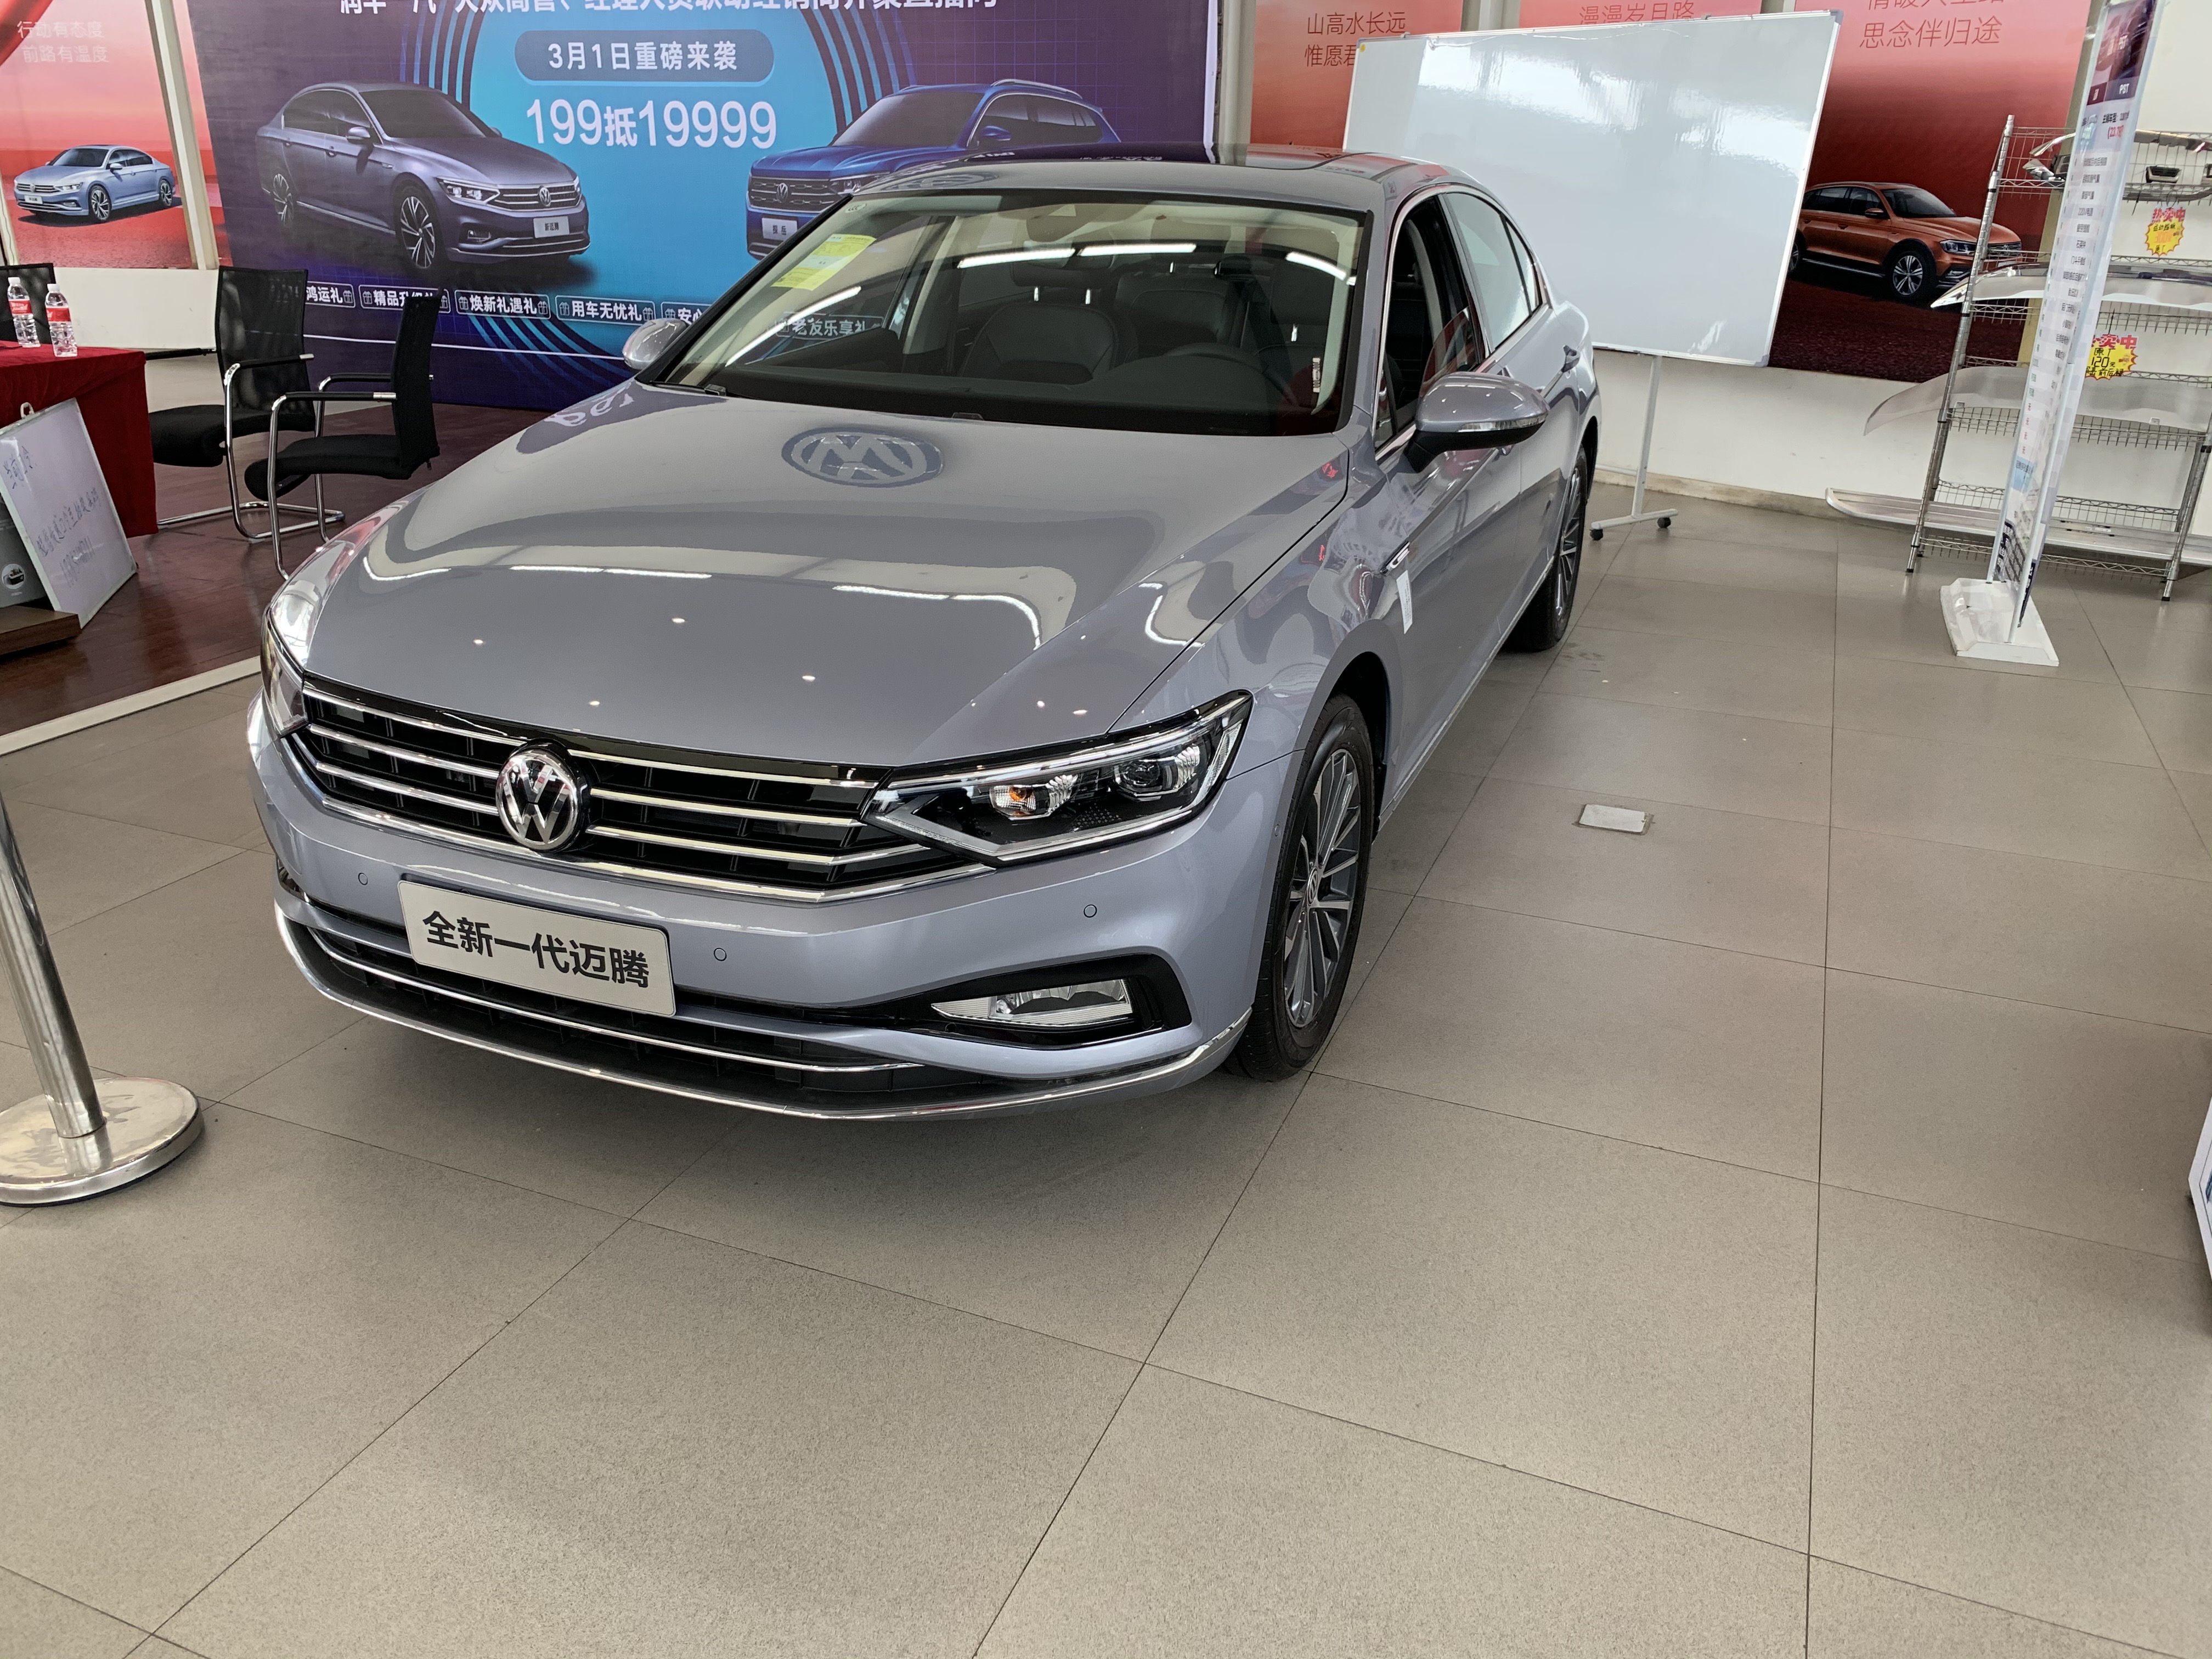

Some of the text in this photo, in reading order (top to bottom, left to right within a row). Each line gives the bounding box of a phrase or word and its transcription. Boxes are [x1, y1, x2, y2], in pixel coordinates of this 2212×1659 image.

[16, 20, 105, 38] 行动有态度
[1307, 11, 1406, 36] 山高水长远
[1860, 15, 2002, 48] 思念伴归途
[21, 45, 110, 63] 前路有温度
[548, 40, 737, 71] 3月1日重磅来袭
[526, 99, 777, 149] 199抵19999
[470, 295, 538, 315] 焕新礼遇礼
[572, 300, 642, 321] 用车无忧礼
[2091, 356, 2116, 368] 120元
[2094, 348, 2116, 357] 原厂
[422, 911, 650, 988] 全新一代迈腾
